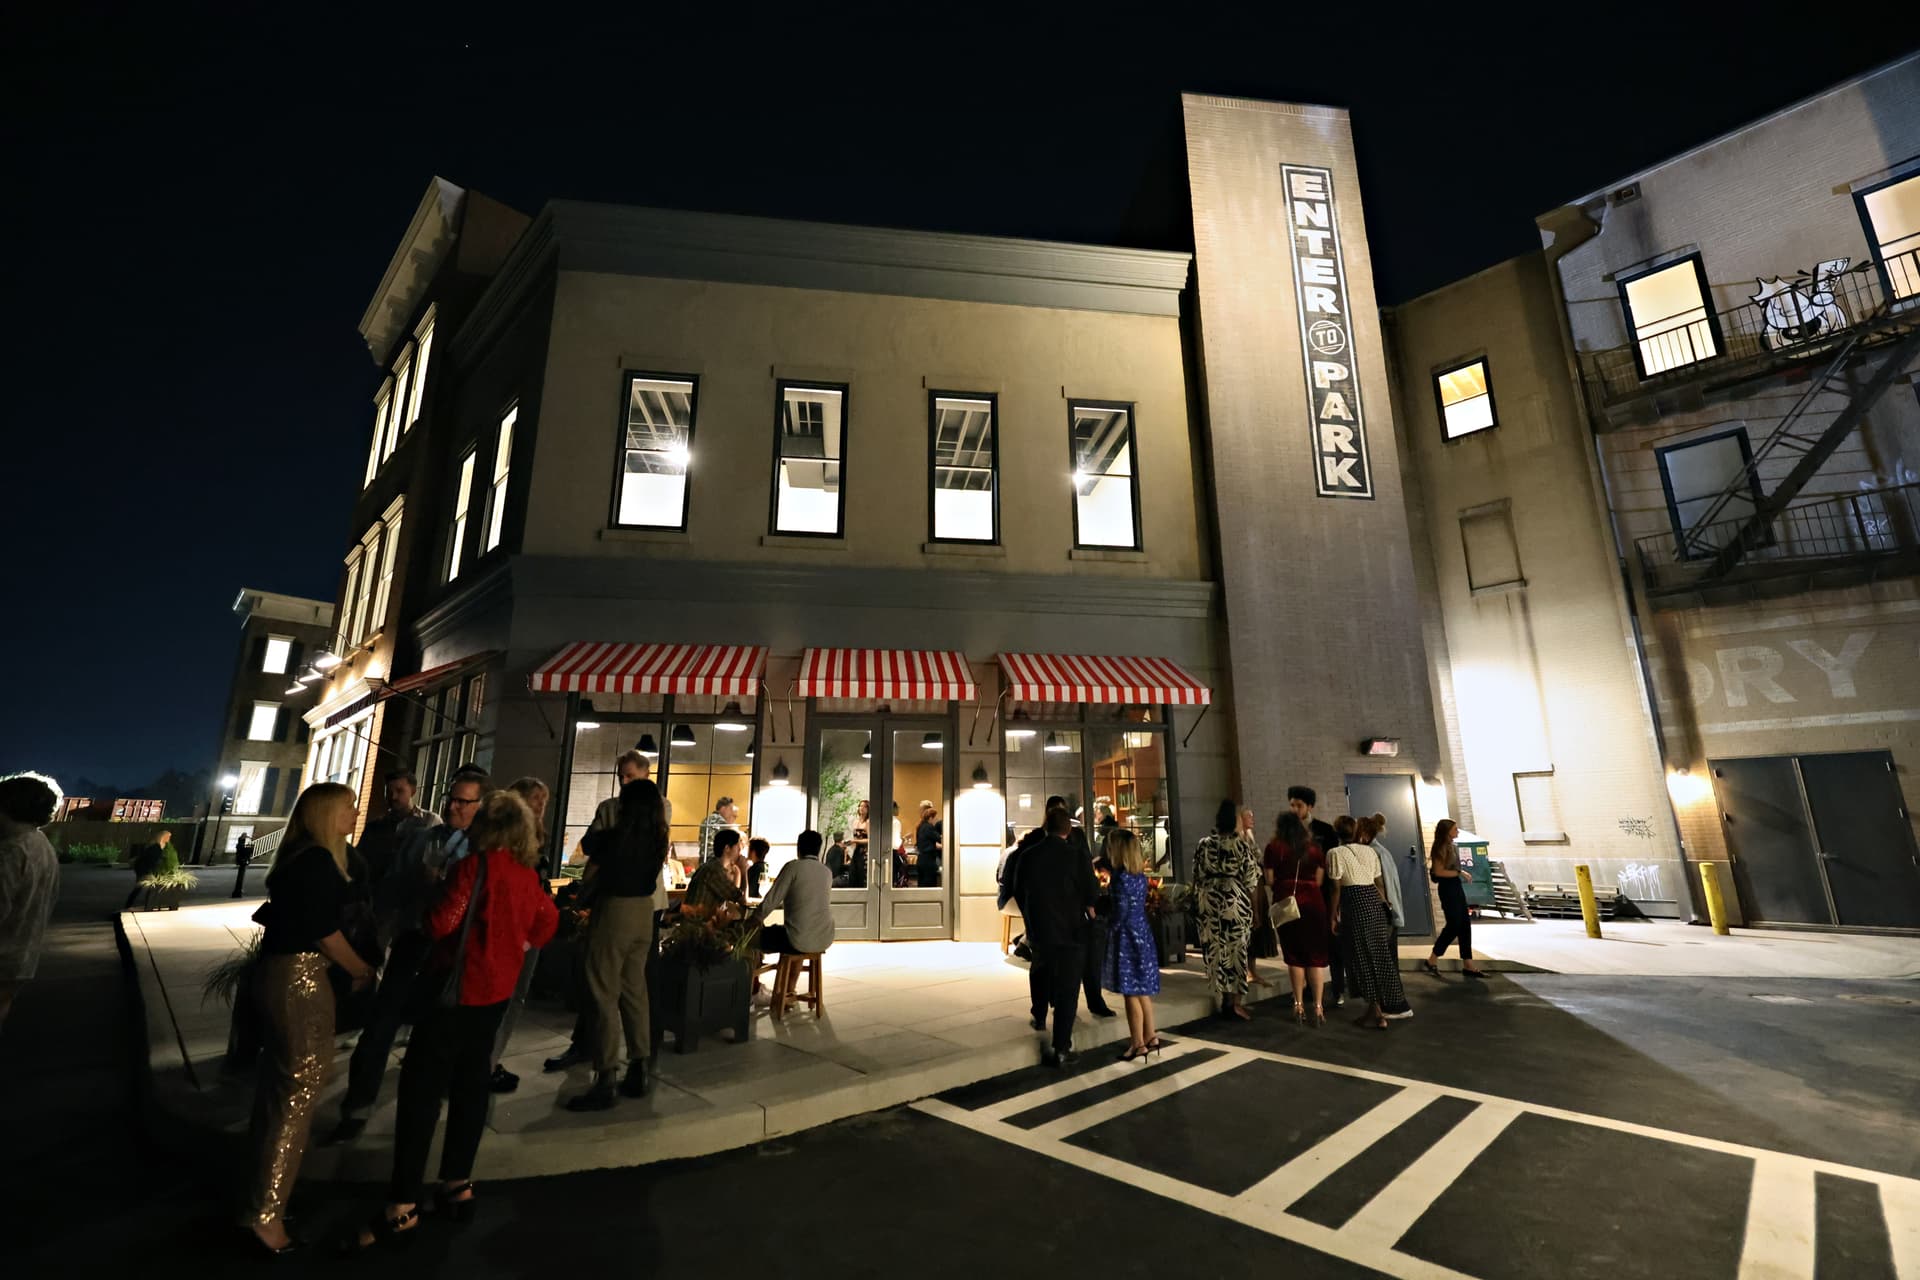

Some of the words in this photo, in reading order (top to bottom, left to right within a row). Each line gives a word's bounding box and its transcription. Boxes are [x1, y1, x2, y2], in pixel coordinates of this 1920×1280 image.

[1290, 172, 1341, 314] ENTER
[1315, 328, 1338, 346] TO
[1312, 360, 1362, 488] PARK
